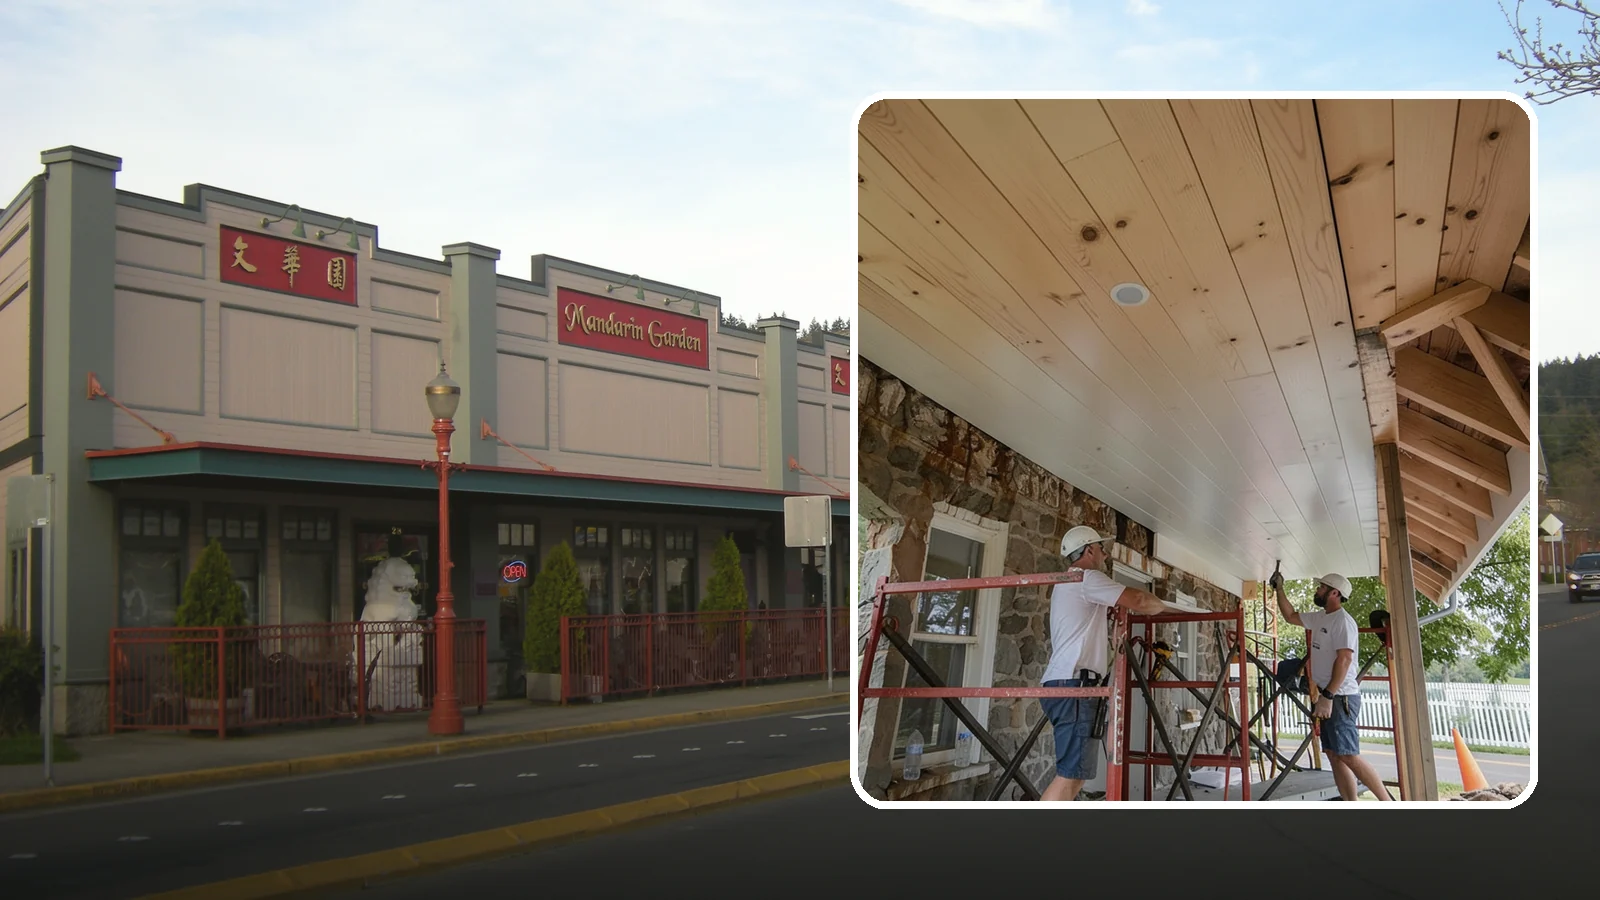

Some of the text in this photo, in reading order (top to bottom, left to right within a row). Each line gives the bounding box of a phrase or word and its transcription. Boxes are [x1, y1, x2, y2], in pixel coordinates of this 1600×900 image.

[231, 235, 346, 291] 文華園
[564, 302, 702, 352] Mandarin Garden
[503, 565, 527, 578] OPEN
